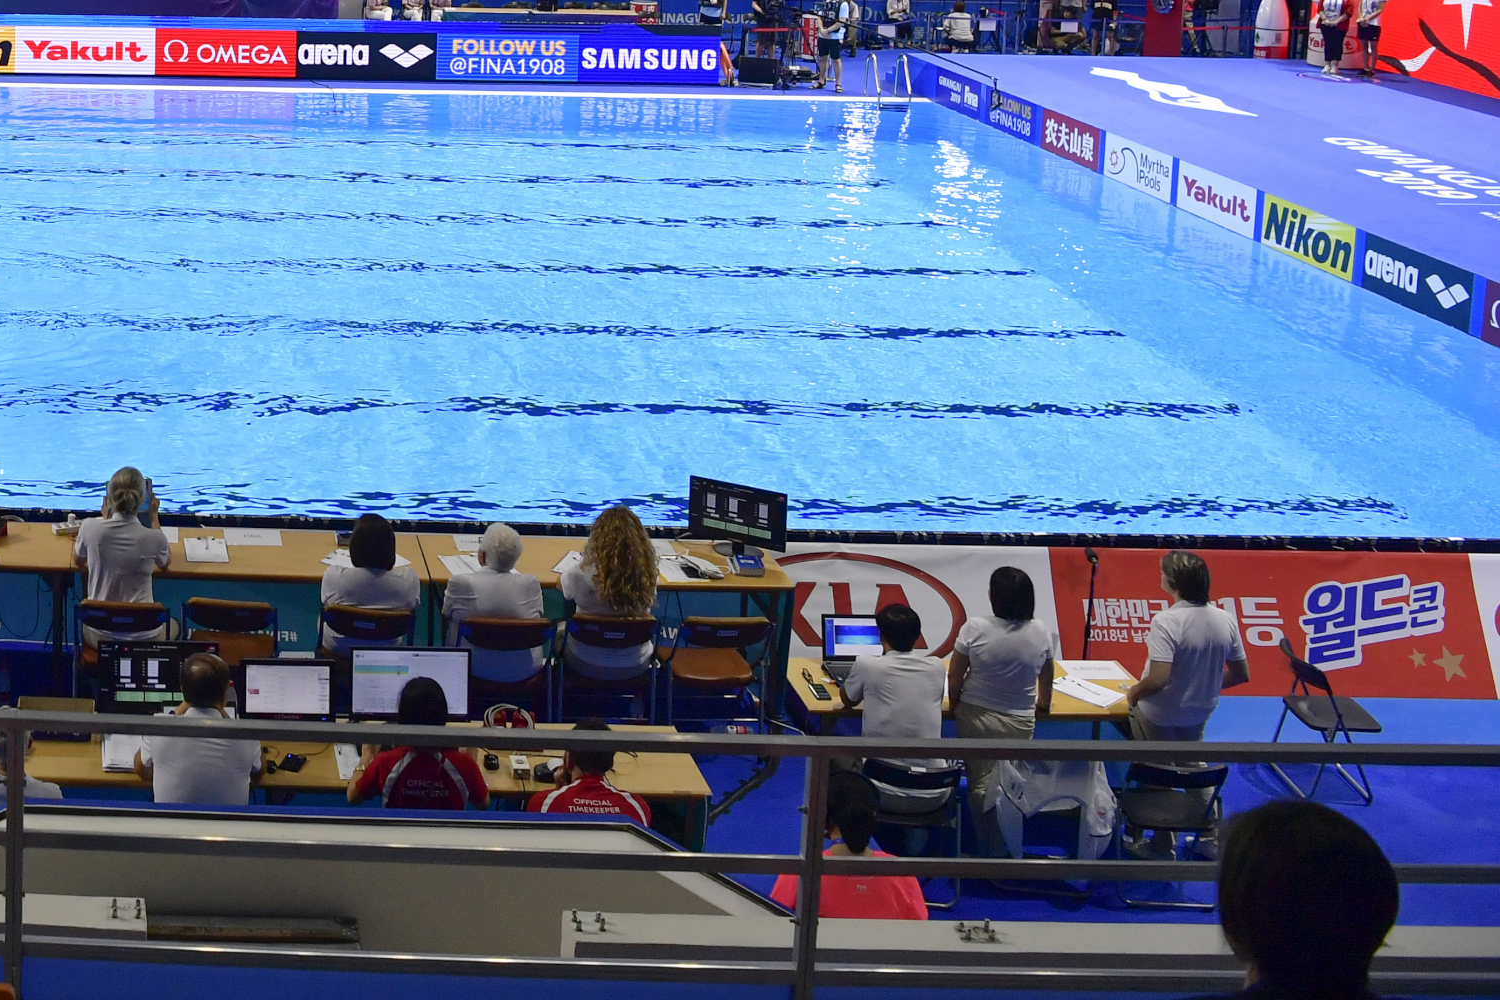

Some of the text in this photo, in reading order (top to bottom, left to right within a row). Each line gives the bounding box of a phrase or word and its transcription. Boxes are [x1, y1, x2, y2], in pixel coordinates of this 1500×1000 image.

[23, 40, 148, 63] Yakult
[196, 43, 289, 65] OMEGA
[298, 43, 370, 66] arena
[451, 39, 566, 57] FOLLOW US
[581, 47, 717, 71] SAMSUNG
[449, 56, 566, 76] @FINA1908
[938, 75, 962, 93] GWANGJU
[950, 91, 961, 105] 2019
[989, 109, 1031, 137] @FINA1908
[1021, 103, 1032, 120] US
[1044, 117, 1095, 162] 农夫山泉
[1139, 152, 1169, 178] Myrtha
[1323, 137, 1500, 201] GWANGJ
[1139, 170, 1161, 192] Pools
[1355, 169, 1478, 199] 2019
[1182, 174, 1251, 223] Yakult
[1263, 202, 1353, 274] Nikon
[1364, 249, 1419, 295] arena
[567, 805, 621, 815] TIMEKEEPER
[572, 797, 613, 807] OFFICIAL
